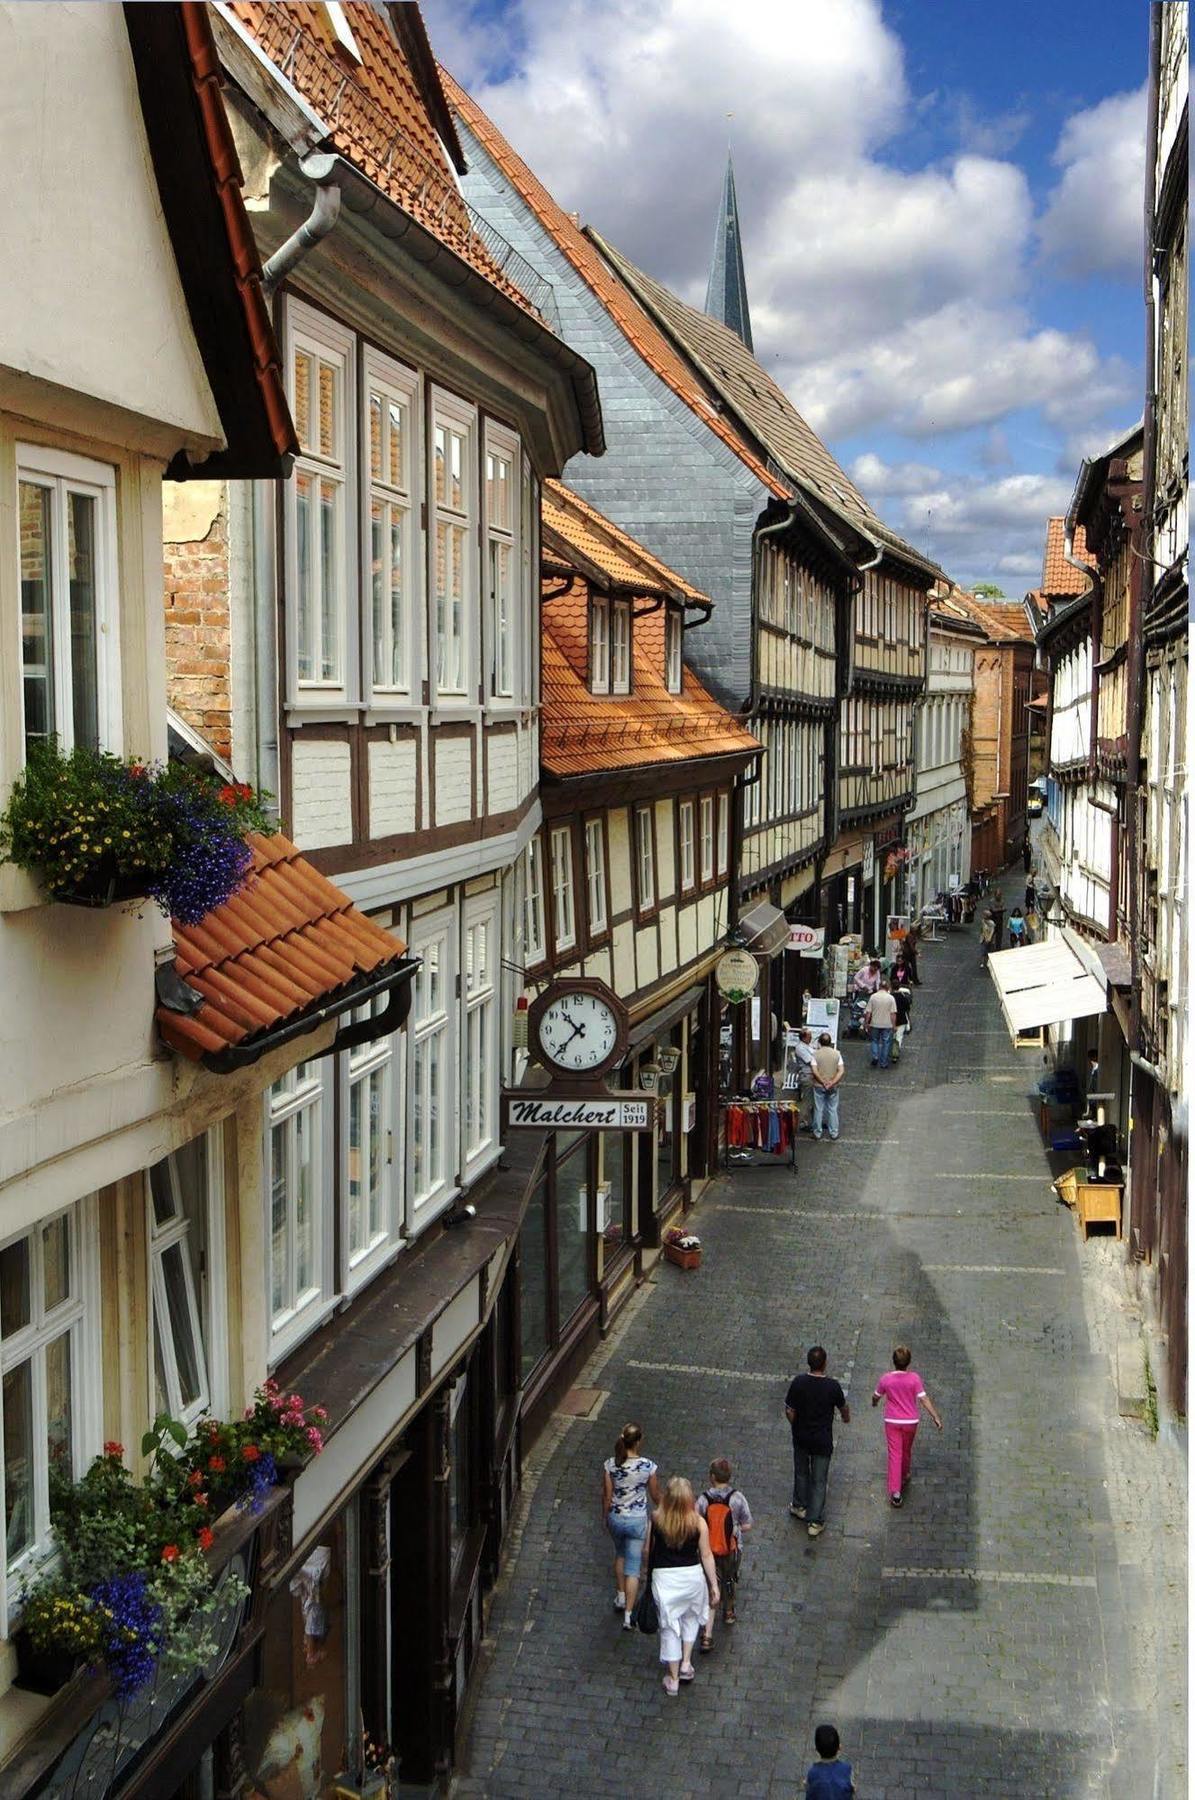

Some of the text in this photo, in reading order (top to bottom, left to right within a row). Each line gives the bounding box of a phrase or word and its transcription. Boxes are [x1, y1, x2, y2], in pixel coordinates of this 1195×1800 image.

[790, 932, 813, 943] TTO
[545, 1025, 552, 1035] 9
[513, 1102, 616, 1124] Malchert
[623, 1104, 644, 1113] Seit
[624, 1115, 645, 1124] 1919
